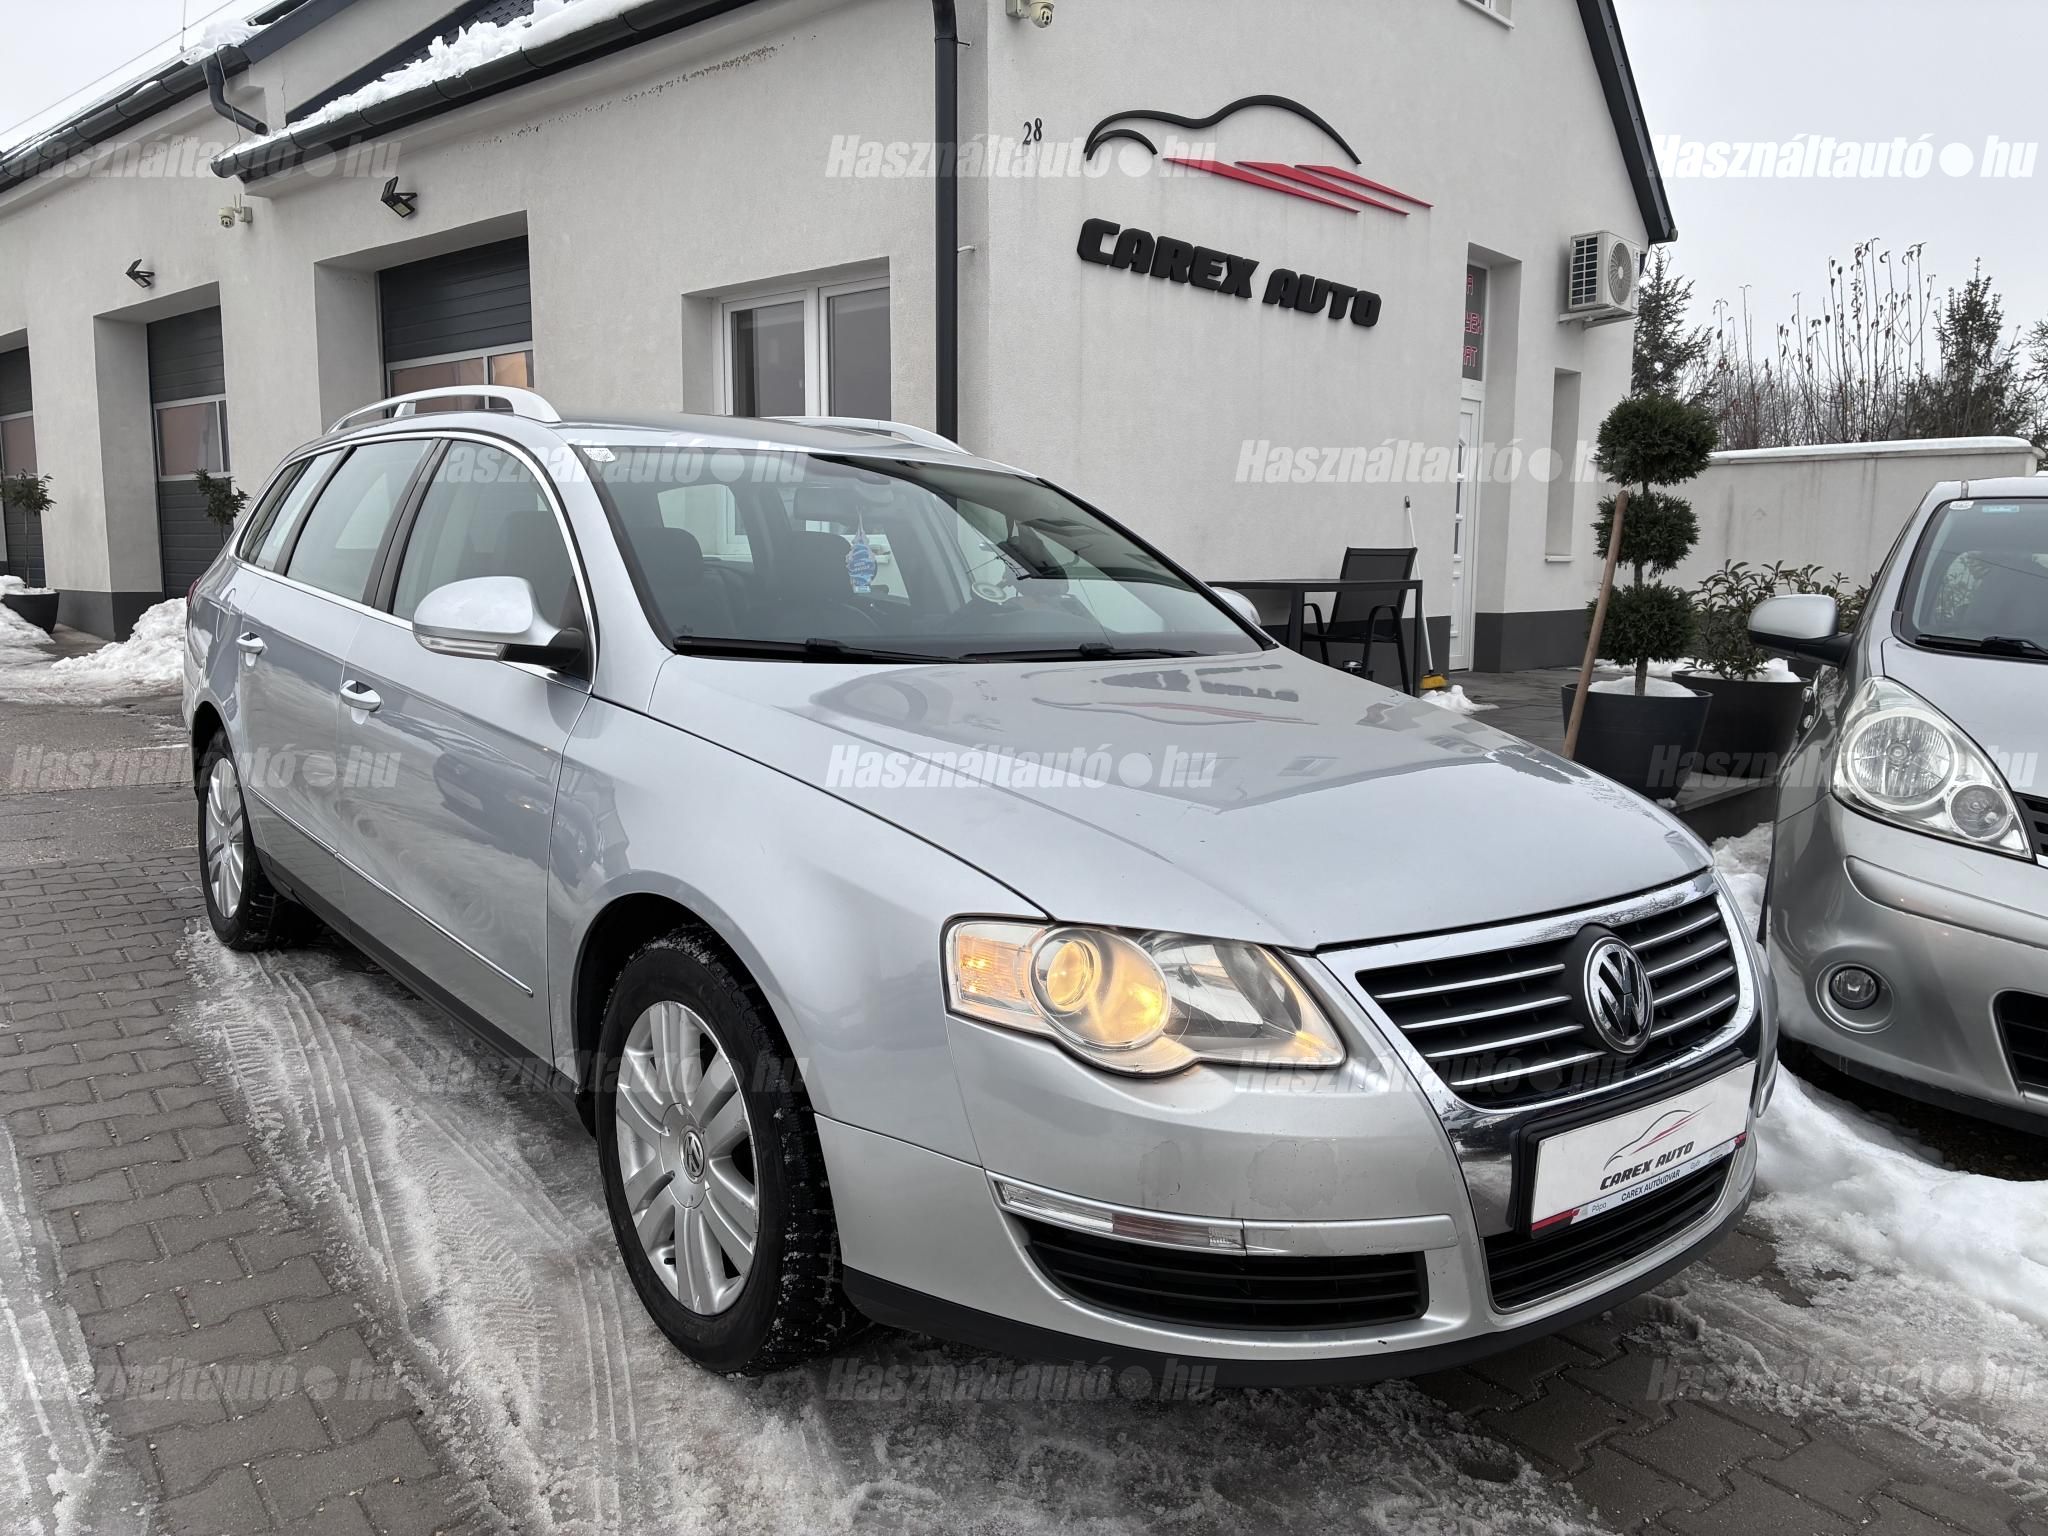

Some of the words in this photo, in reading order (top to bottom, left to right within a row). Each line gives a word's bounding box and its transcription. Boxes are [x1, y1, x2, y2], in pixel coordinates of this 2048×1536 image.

[1022, 117, 1042, 145] 28
[1077, 218, 1259, 298] CAREX
[1262, 268, 1382, 327] AUTO
[1600, 1158, 1652, 1190] CAREX
[1655, 1141, 1694, 1168] AUTO
[1621, 1184, 1644, 1201] CAREX
